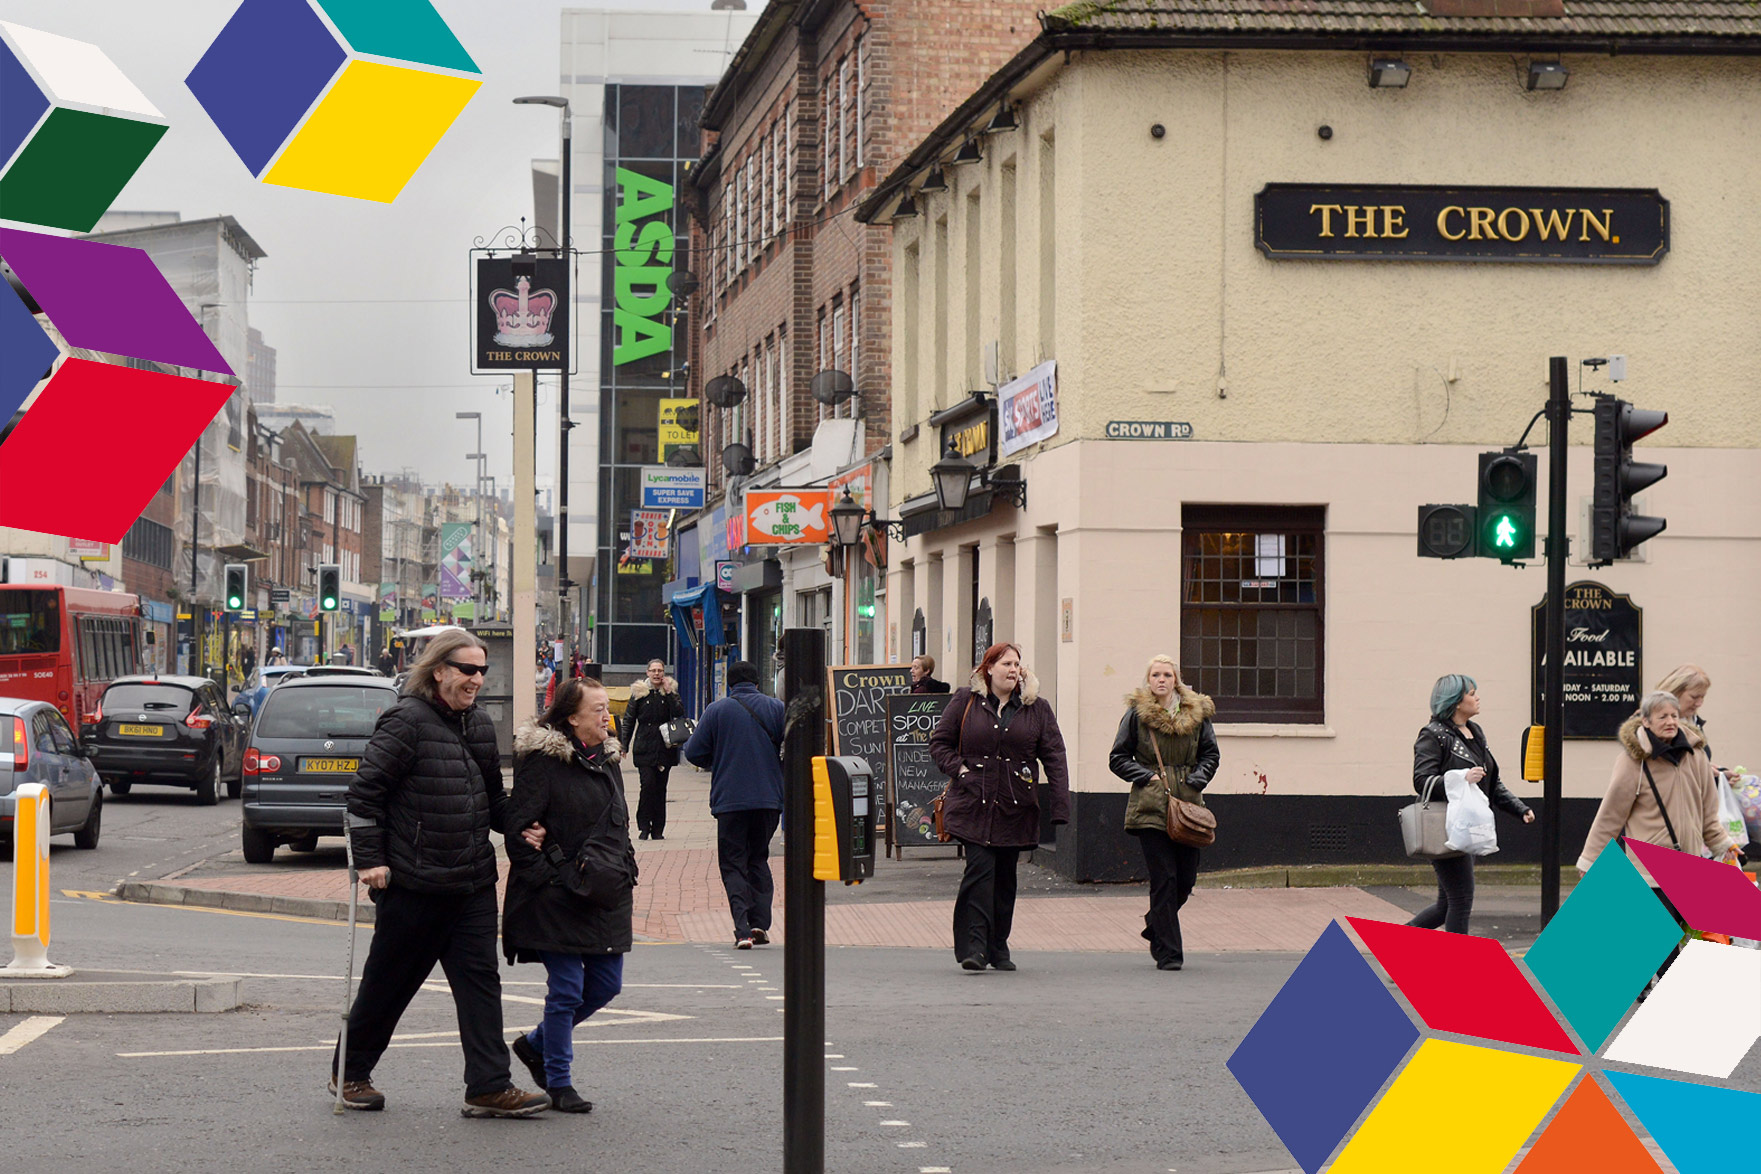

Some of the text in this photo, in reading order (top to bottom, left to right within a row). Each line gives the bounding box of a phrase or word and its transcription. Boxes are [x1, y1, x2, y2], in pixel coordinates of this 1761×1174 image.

[1309, 203, 1410, 239] THE
[613, 166, 675, 367] ASDA
[486, 351, 561, 361] THE CROWN
[1014, 391, 1040, 429] SPORTS
[667, 430, 697, 440] TO LET
[1108, 422, 1166, 438] CROWN
[647, 473, 700, 484] Lycamobile
[652, 489, 695, 498] SUPER SAVE
[775, 502, 797, 513] FISH
[782, 513, 790, 524] &
[772, 524, 800, 535] CHIPS
[1573, 588, 1603, 599] THE
[1564, 599, 1613, 610] CROWN
[1566, 627, 1610, 642] Food
[1541, 650, 1635, 667] AILABLE
[844, 672, 905, 689] Crown
[1591, 683, 1631, 692] SATURDAY
[1565, 693, 1592, 702] NOON
[1601, 693, 1620, 702] 2.00
[1622, 693, 1636, 702] PM
[907, 700, 938, 714] LIVE
[839, 719, 886, 737] COMPET
[892, 715, 942, 731] SPOR
[123, 725, 142, 734] BK61
[895, 732, 909, 743] at
[909, 728, 928, 744] The
[898, 748, 932, 763] UNDE
[306, 759, 358, 771] KY07 HZJ
[898, 765, 928, 778] NEW
